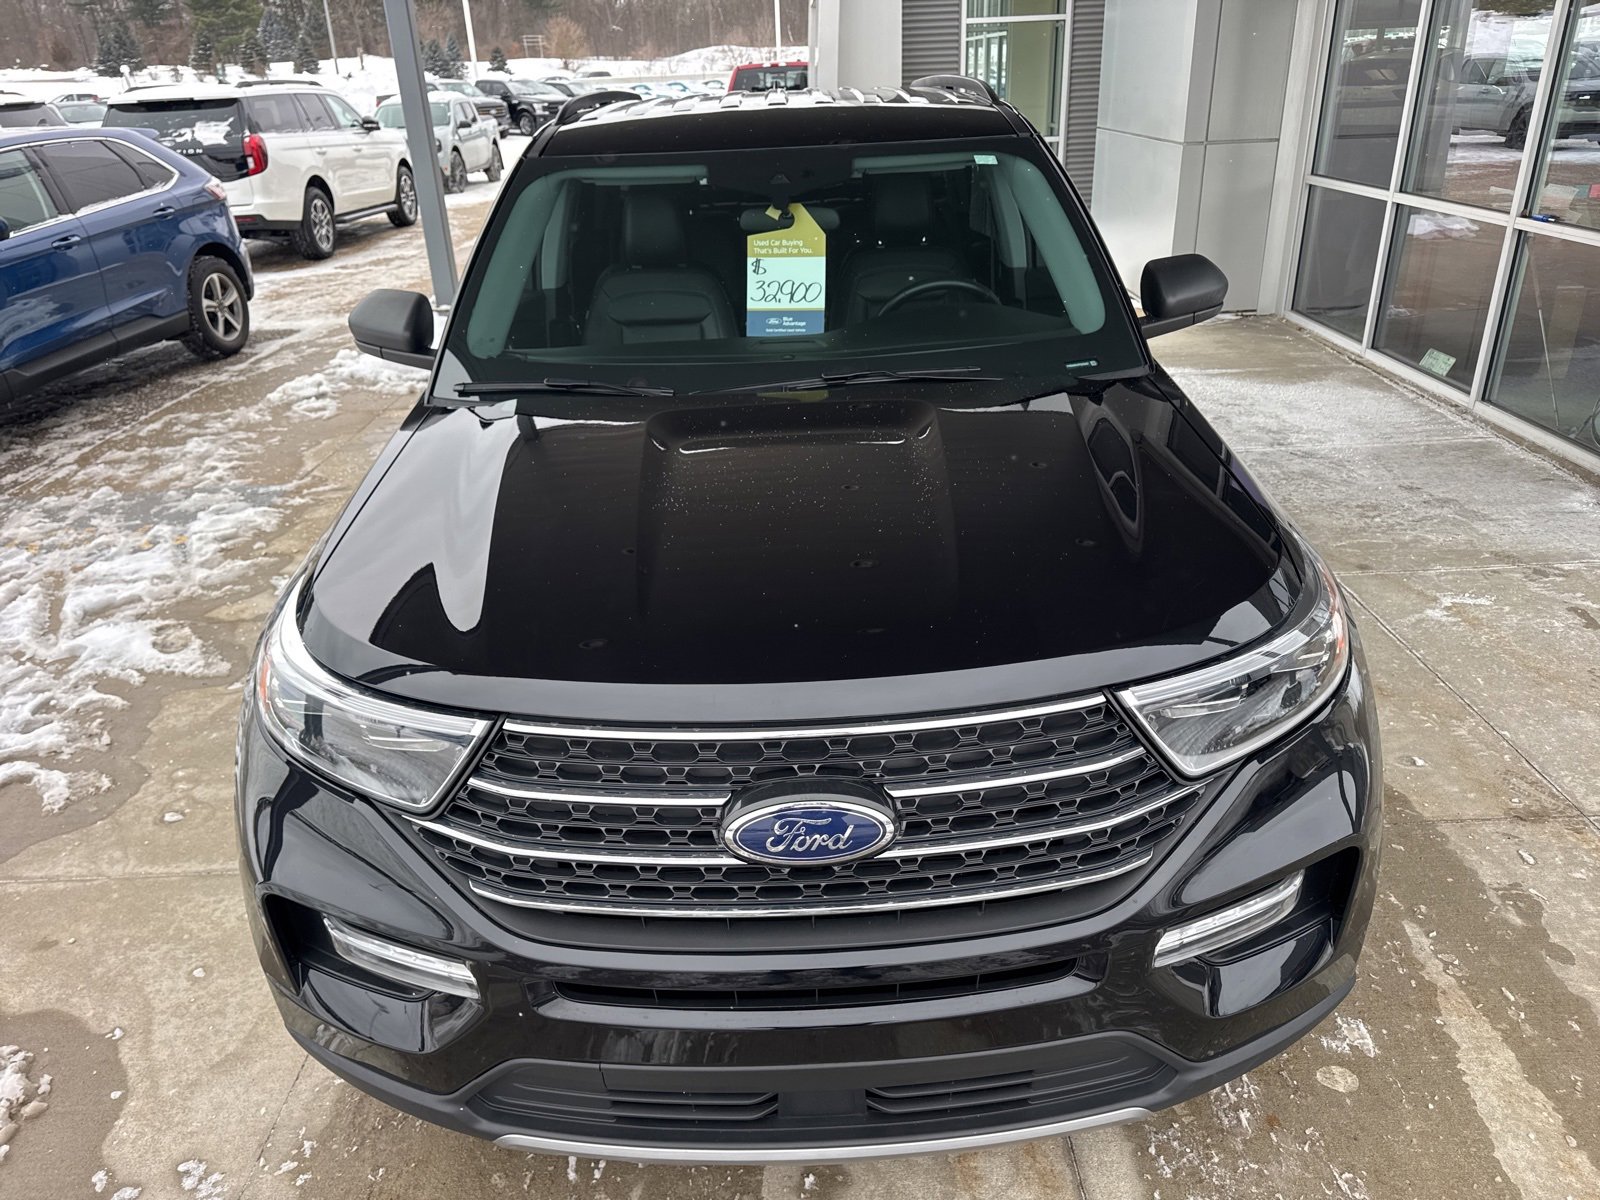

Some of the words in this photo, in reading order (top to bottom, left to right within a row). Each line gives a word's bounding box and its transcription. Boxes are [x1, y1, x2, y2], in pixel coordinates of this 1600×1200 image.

[782, 239, 803, 247] Buying
[751, 257, 767, 275] $
[766, 817, 855, 853] Ford
